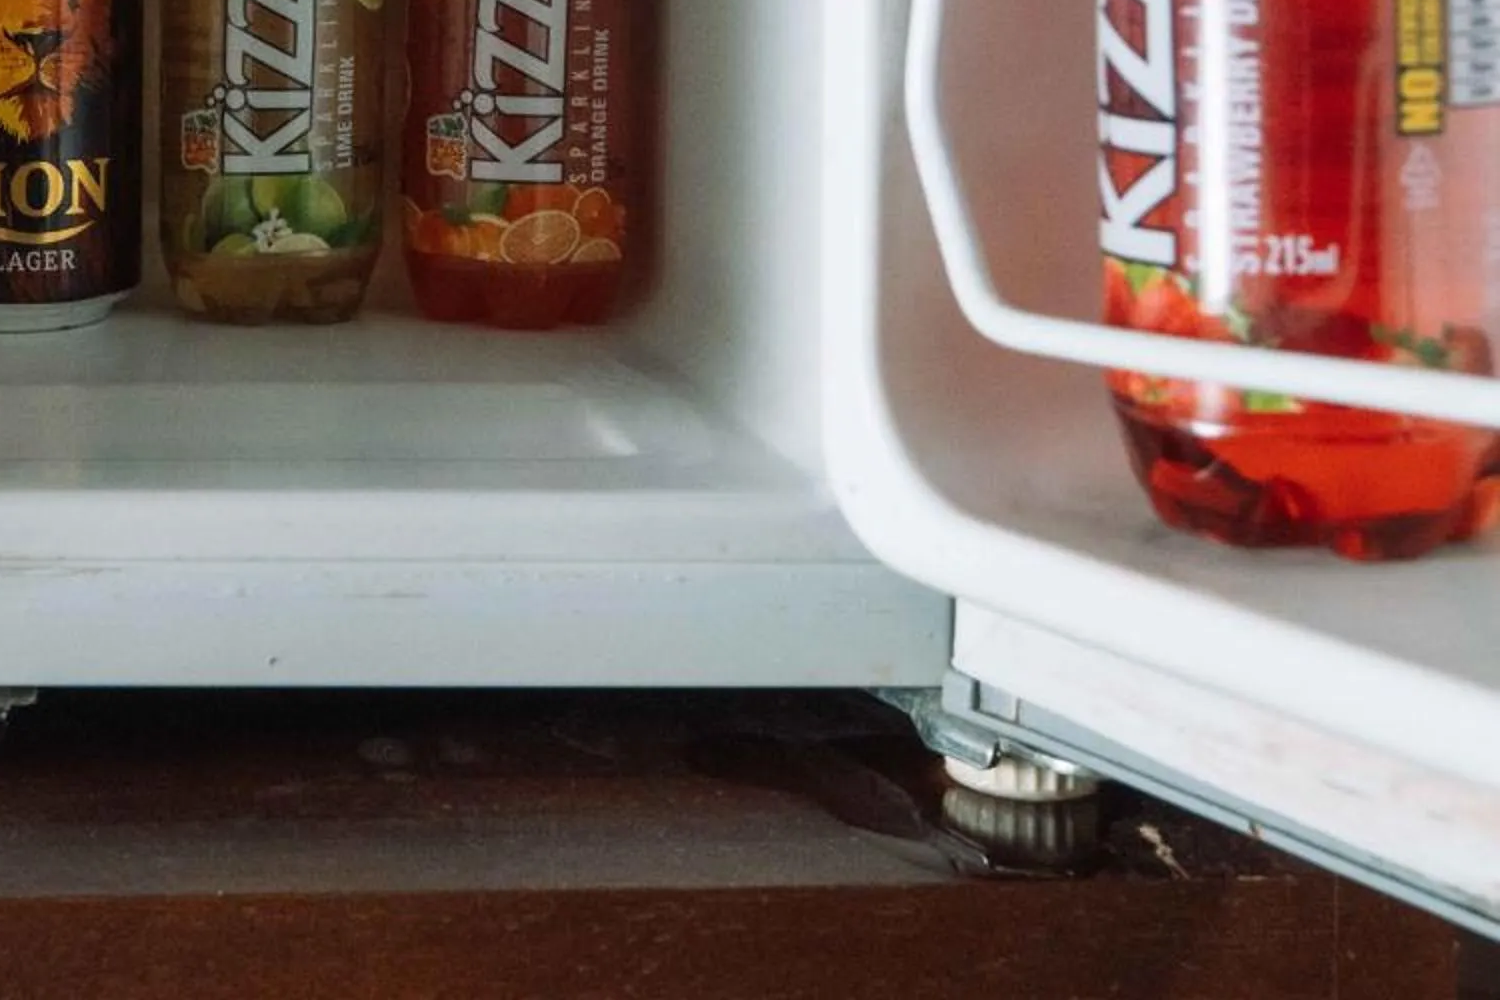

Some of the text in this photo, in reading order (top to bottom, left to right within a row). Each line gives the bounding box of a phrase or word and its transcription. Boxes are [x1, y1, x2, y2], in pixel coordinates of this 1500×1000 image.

[336, 55, 355, 169] LIME DRINK
[590, 29, 609, 184] ORANGE DRINK
[1400, 69, 1439, 131] NO
